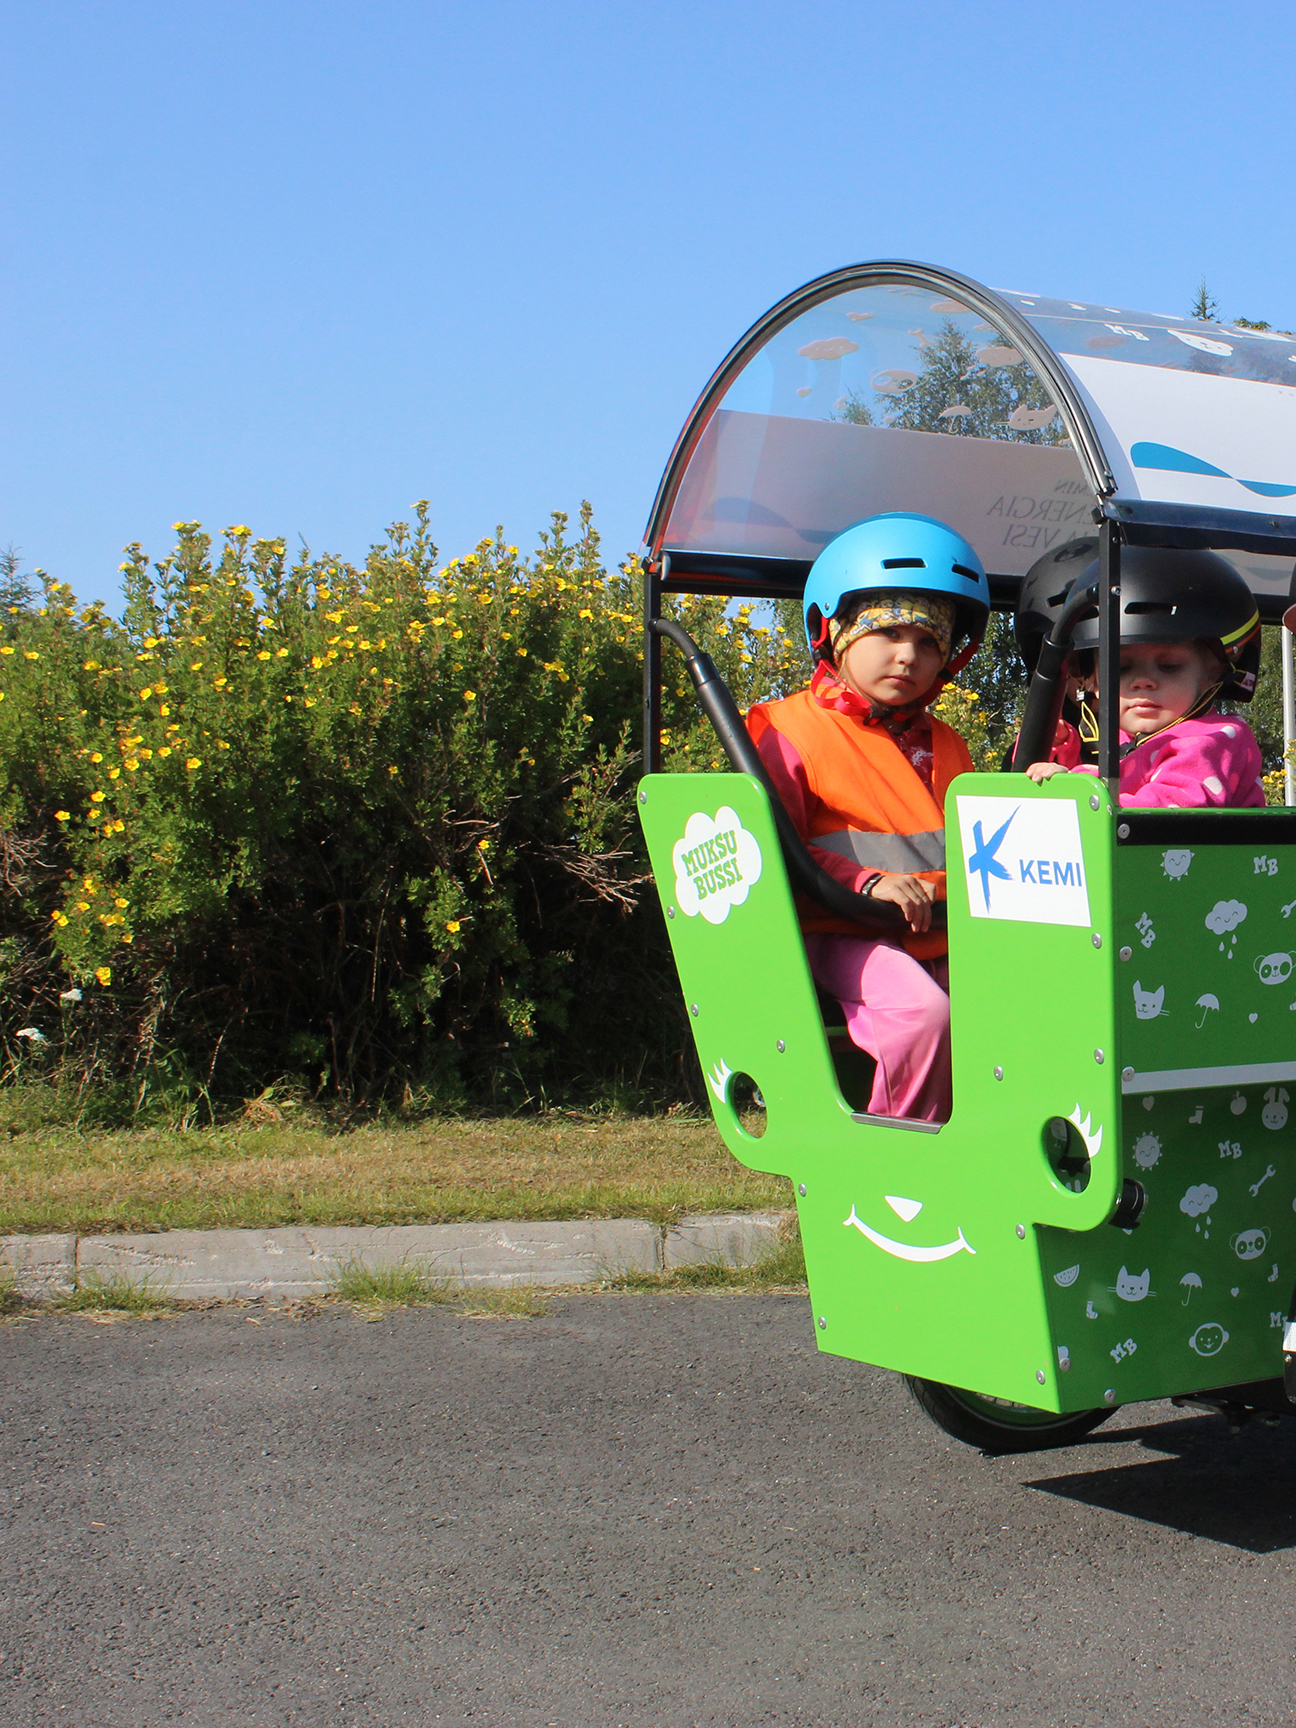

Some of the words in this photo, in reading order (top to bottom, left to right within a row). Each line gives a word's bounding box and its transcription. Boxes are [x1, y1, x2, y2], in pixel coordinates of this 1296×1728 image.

[680, 830, 738, 877] MUKSU
[1254, 854, 1279, 877] MB
[693, 857, 744, 901] BUSSI
[1019, 859, 1082, 887] KEMI
[1134, 911, 1156, 949] MB
[1217, 1140, 1242, 1160] MB
[1109, 1338, 1138, 1364] MB
